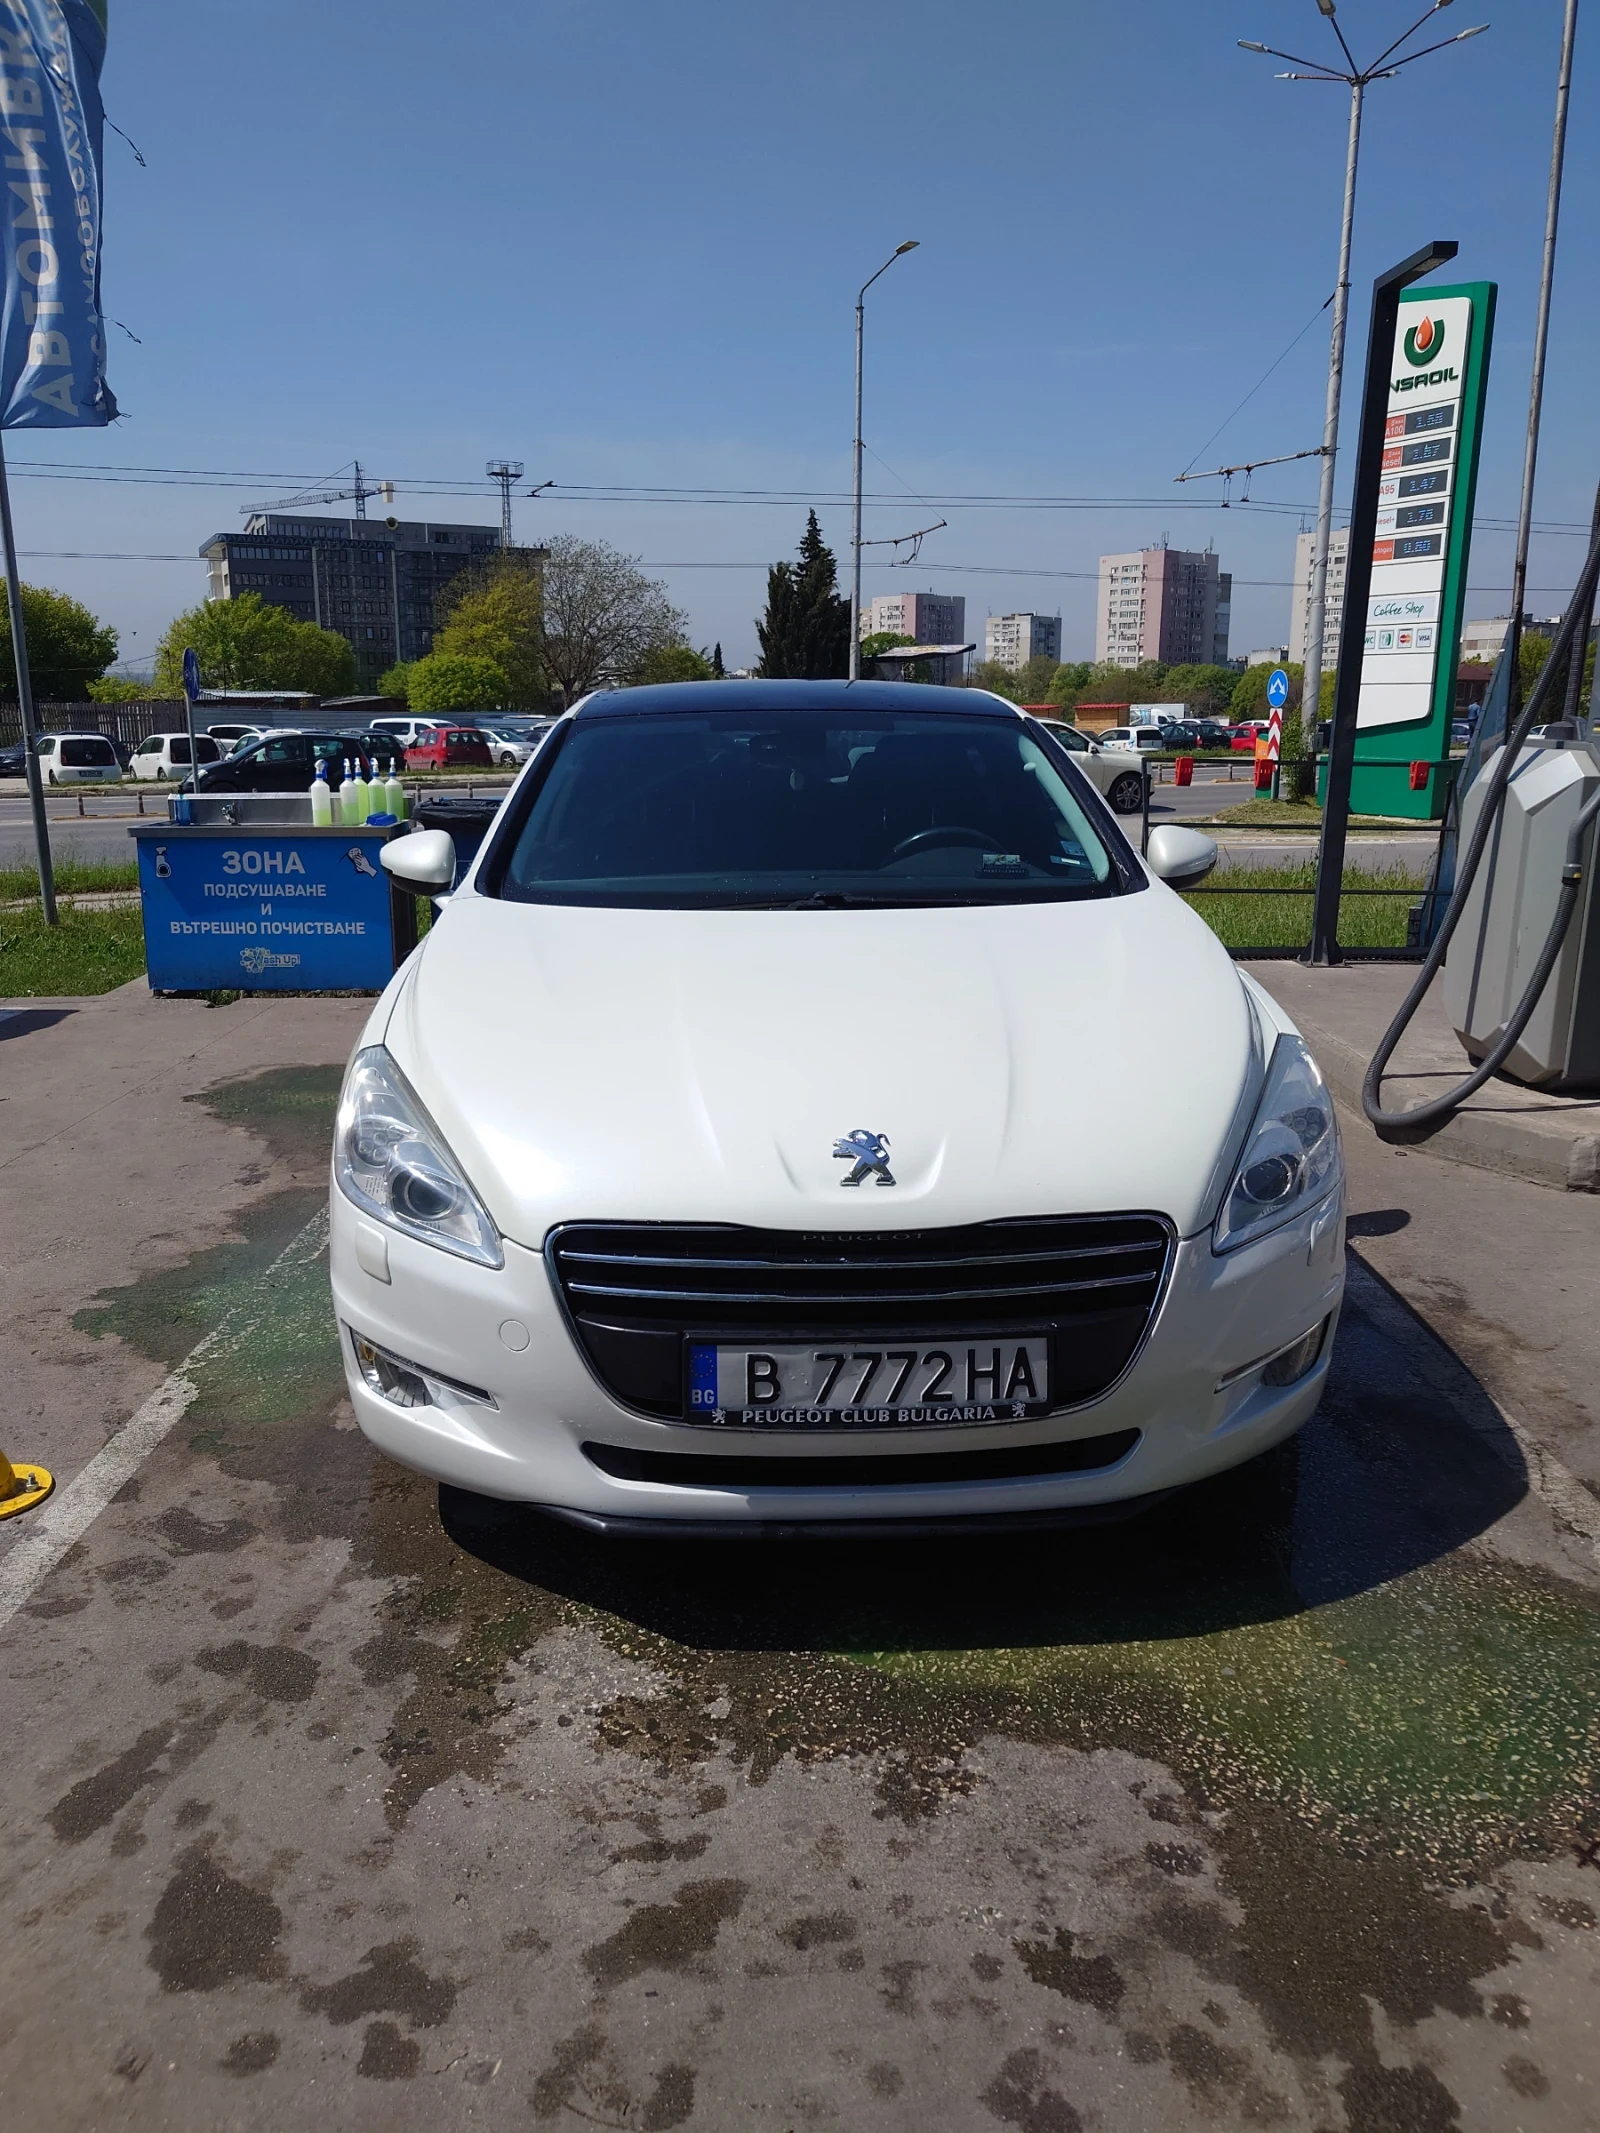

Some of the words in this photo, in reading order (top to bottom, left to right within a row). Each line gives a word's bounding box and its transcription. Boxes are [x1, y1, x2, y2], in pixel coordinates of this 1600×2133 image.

[0, 0, 79, 418] АВТОМИВК
[1390, 367, 1459, 393] NSAOIL
[1381, 455, 1400, 467] iesel
[1379, 484, 1395, 496] A95
[1375, 516, 1395, 525] iesel+
[1374, 602, 1402, 616] Coffee
[1405, 601, 1425, 618] Shop
[222, 851, 306, 874] ЗОНА
[204, 884, 327, 898] ПОДСУШАВАНЕ
[261, 904, 272, 915] И
[170, 921, 257, 935] ВЪТРЕШНО
[260, 921, 366, 935] ПОЧИСТВАНЕ
[254, 955, 281, 965] Wash
[283, 955, 300, 966] Up!
[802, 1232, 928, 1242] PEUGEOT
[745, 1353, 780, 1405] B
[691, 1389, 715, 1405] BG
[742, 1409, 834, 1424] PEUGEOT
[841, 1409, 890, 1423] CLUB
[898, 1405, 996, 1422] BULGARIA
